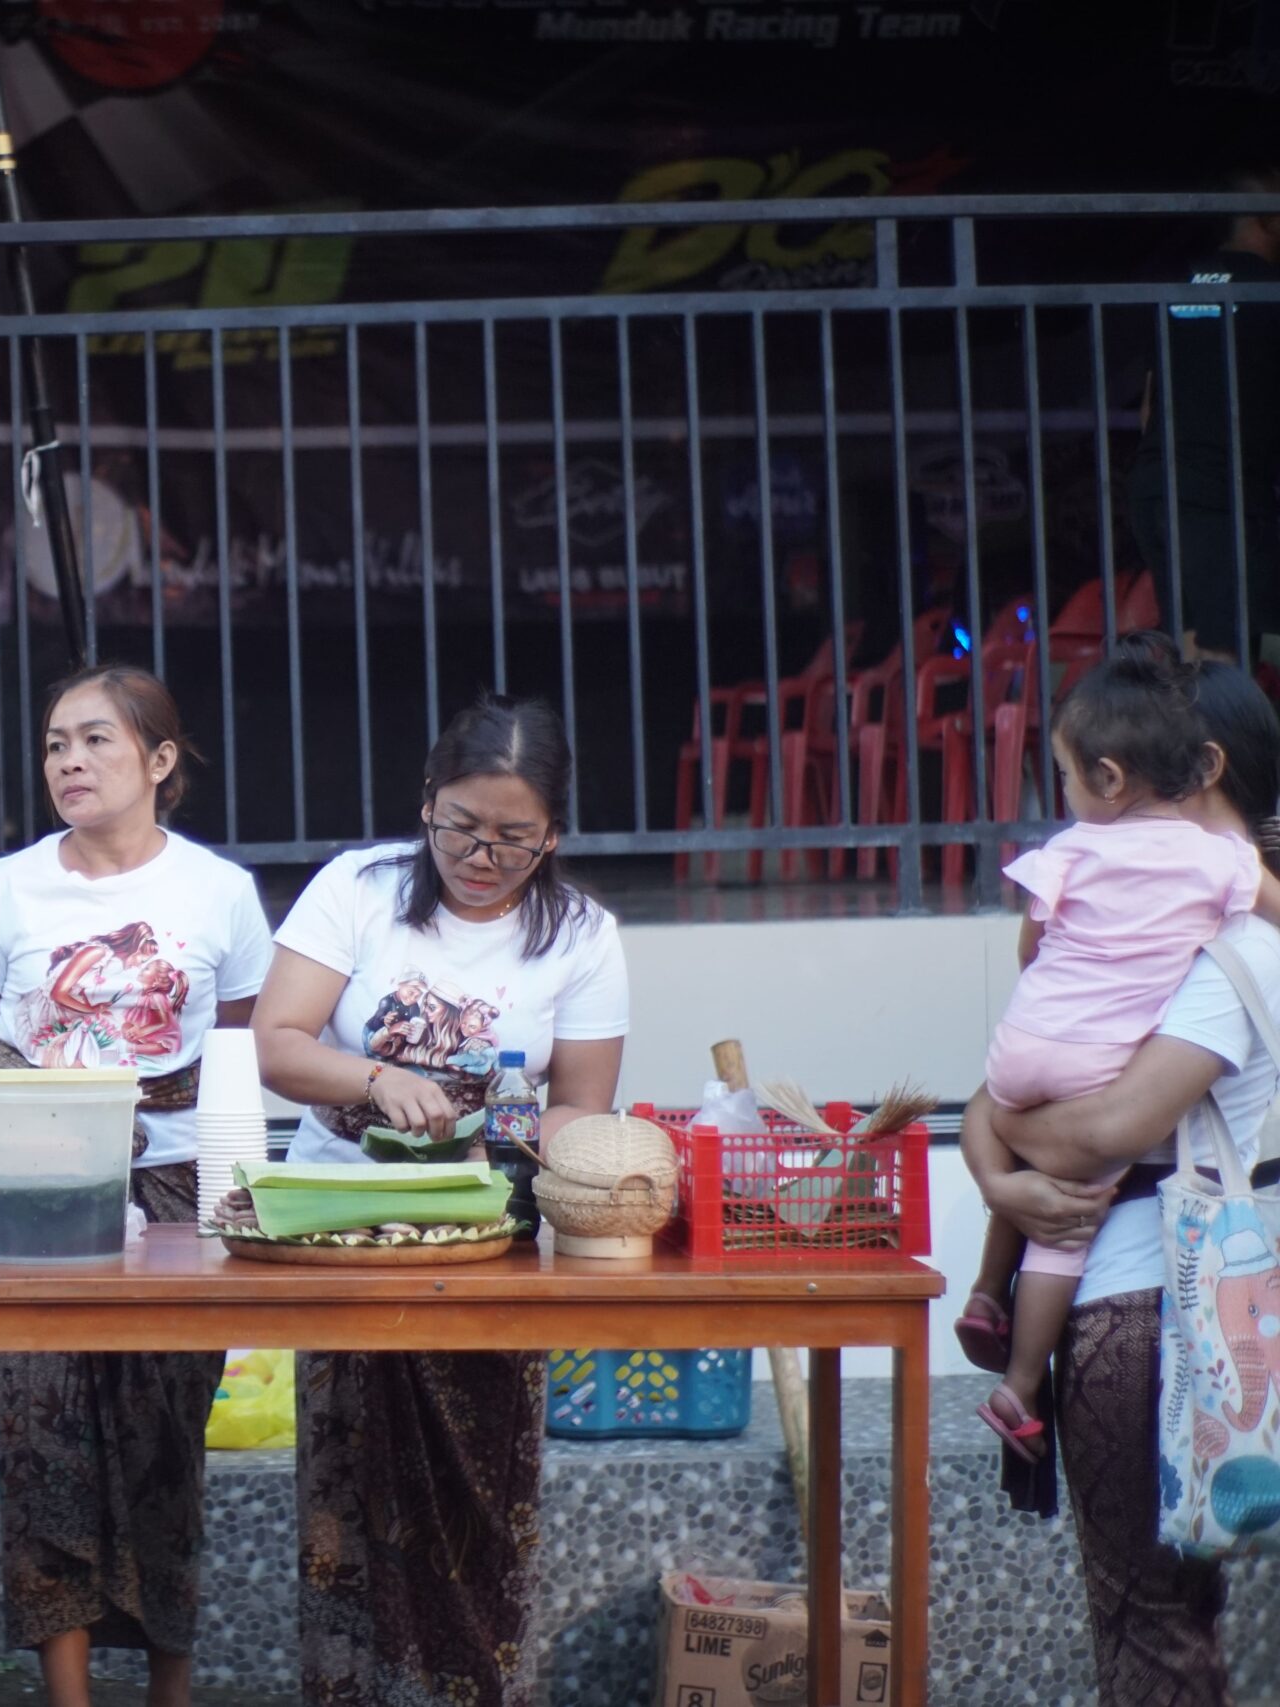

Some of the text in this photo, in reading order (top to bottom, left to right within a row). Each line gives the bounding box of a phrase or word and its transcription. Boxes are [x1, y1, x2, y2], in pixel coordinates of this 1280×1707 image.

[533, 5, 962, 49] Munduk Racing Team
[690, 1613, 762, 1634] 64827398
[684, 1634, 732, 1657] LIME
